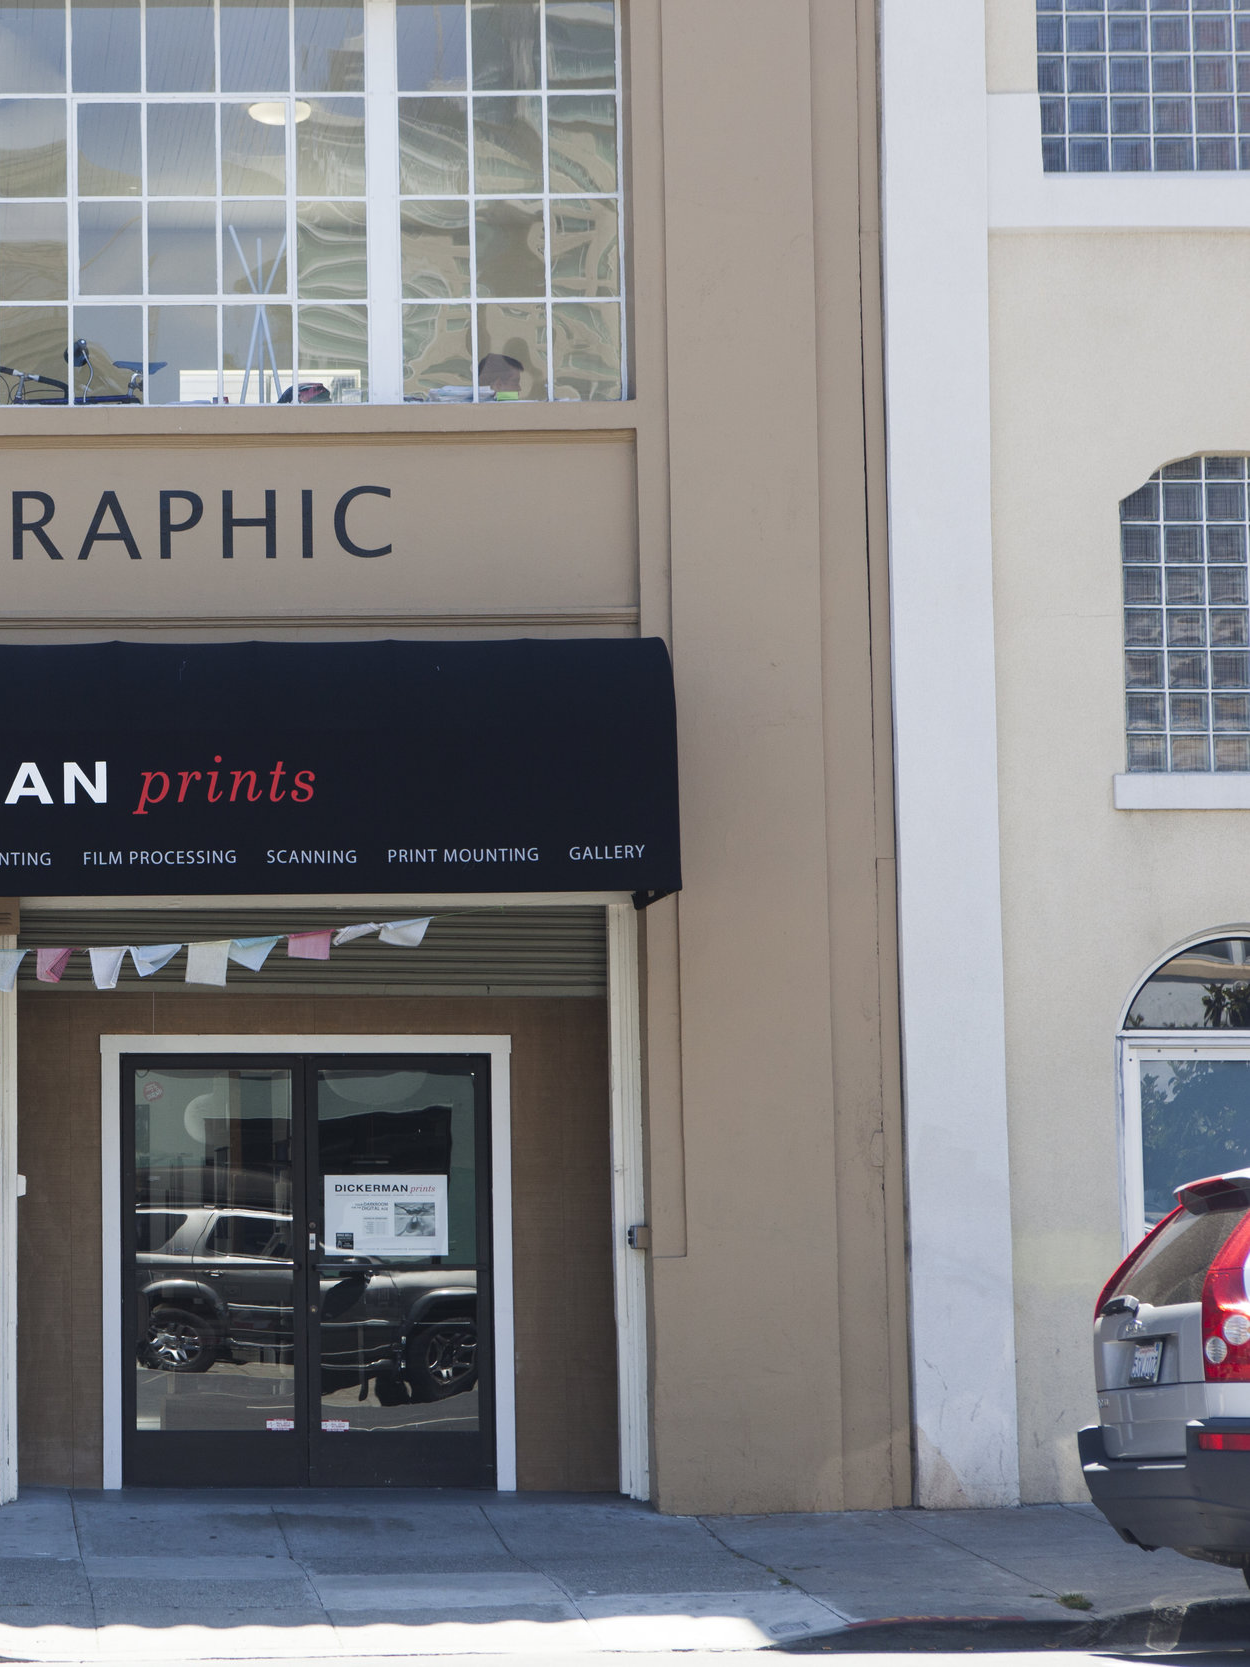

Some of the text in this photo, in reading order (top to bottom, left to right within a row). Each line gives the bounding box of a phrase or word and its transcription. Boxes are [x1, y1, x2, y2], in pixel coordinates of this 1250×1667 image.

[133, 755, 316, 815] prints
[83, 849, 237, 866] FILM PROCESSING
[266, 849, 357, 864] SCANNING
[387, 847, 539, 863] PRINT MOUNTING
[569, 844, 646, 861] GALLERY
[334, 1184, 436, 1194] DICKERMAN prints
